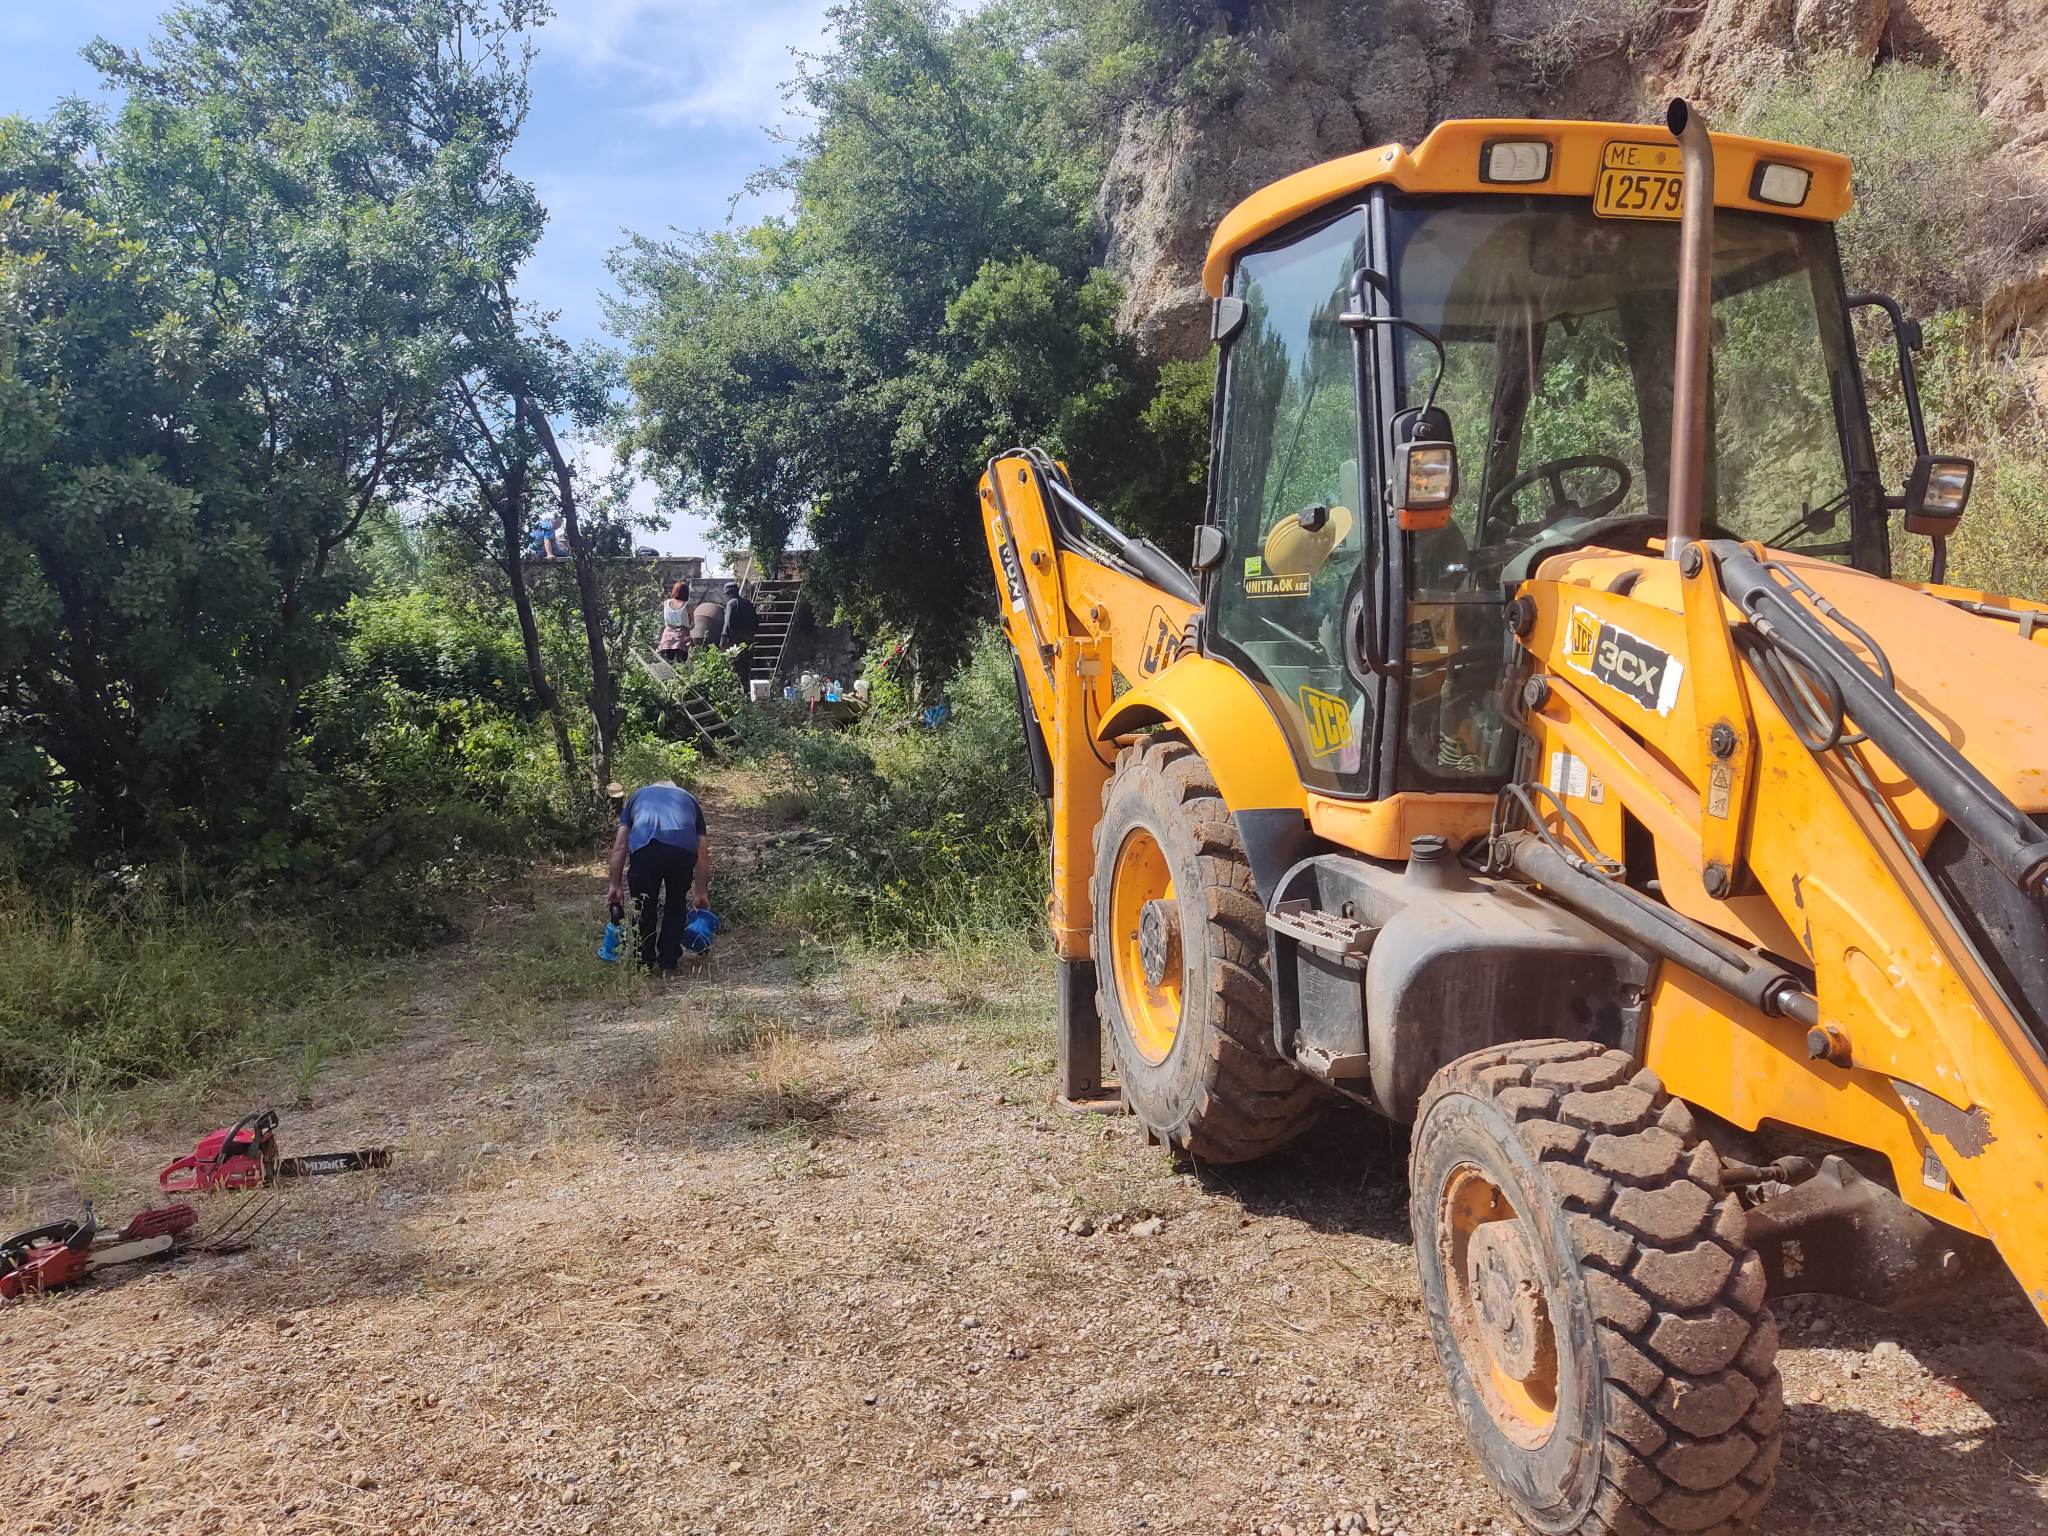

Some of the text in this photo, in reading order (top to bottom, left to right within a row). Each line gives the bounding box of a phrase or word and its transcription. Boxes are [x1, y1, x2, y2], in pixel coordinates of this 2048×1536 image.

[1611, 146, 1639, 165] ME
[1603, 173, 1684, 212] 12579
[1143, 617, 1180, 674] JC
[1598, 640, 1660, 696] 3CX
[1307, 694, 1351, 751] JCB
[303, 1158, 348, 1171] MIYAKE
